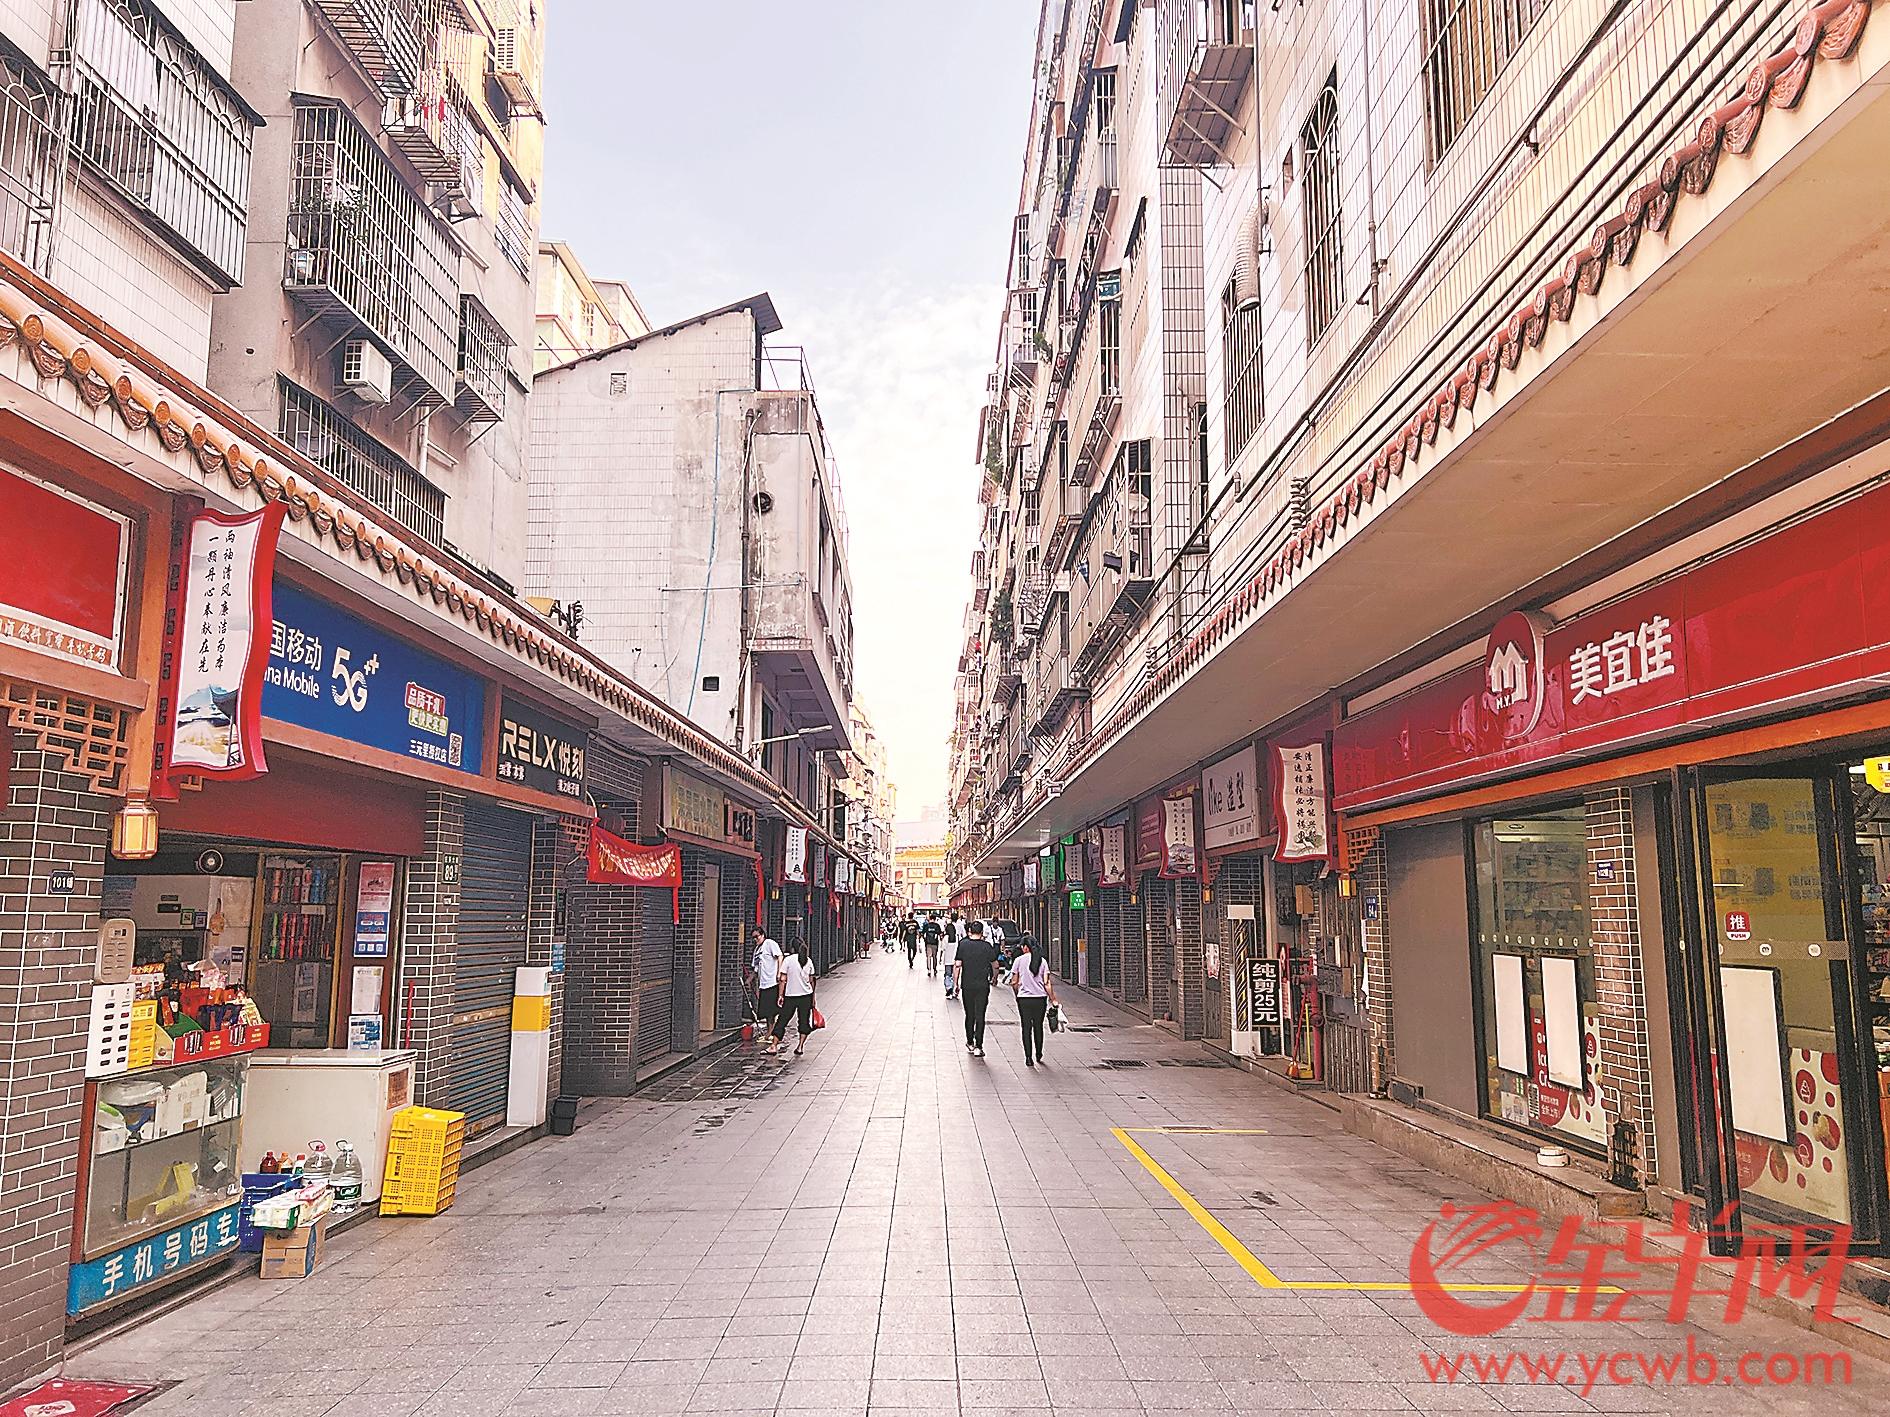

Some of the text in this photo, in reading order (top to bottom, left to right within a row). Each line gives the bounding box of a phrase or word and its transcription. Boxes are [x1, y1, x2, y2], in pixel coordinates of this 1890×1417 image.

[283, 666, 320, 699] Mobile
[1568, 615, 1675, 705] 美宜佳
[502, 718, 557, 772] RELX
[558, 741, 584, 781] 悦刻
[1729, 914, 1746, 930] 推
[1252, 962, 1278, 1022] 纯剪25元
[102, 1211, 240, 1296] 手机号码专
